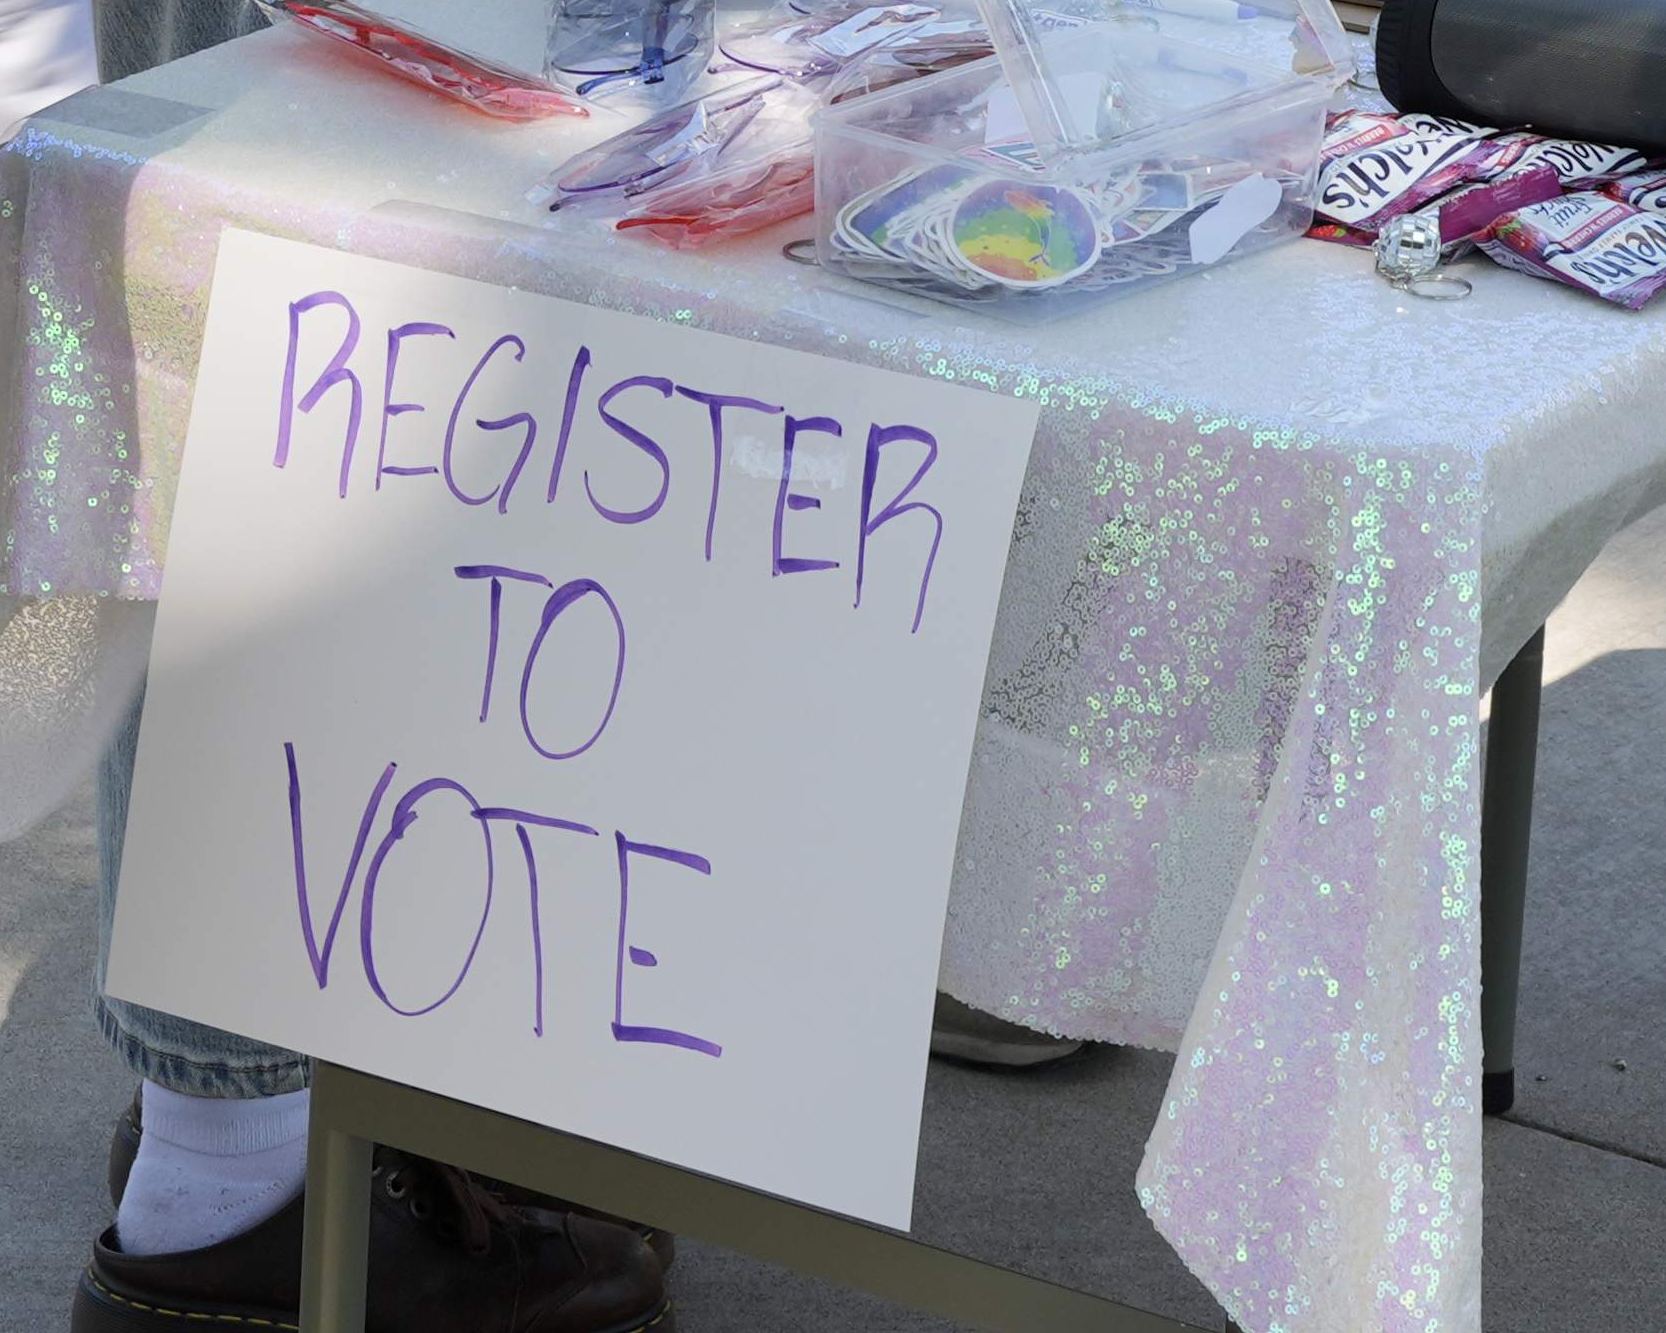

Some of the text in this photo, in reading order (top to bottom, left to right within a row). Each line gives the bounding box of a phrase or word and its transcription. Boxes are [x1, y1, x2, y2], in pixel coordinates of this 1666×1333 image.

[1554, 197, 1595, 229] Fruit
[271, 289, 945, 635] REGISTER
[452, 563, 627, 760] TO
[282, 741, 723, 1059] VOTE
